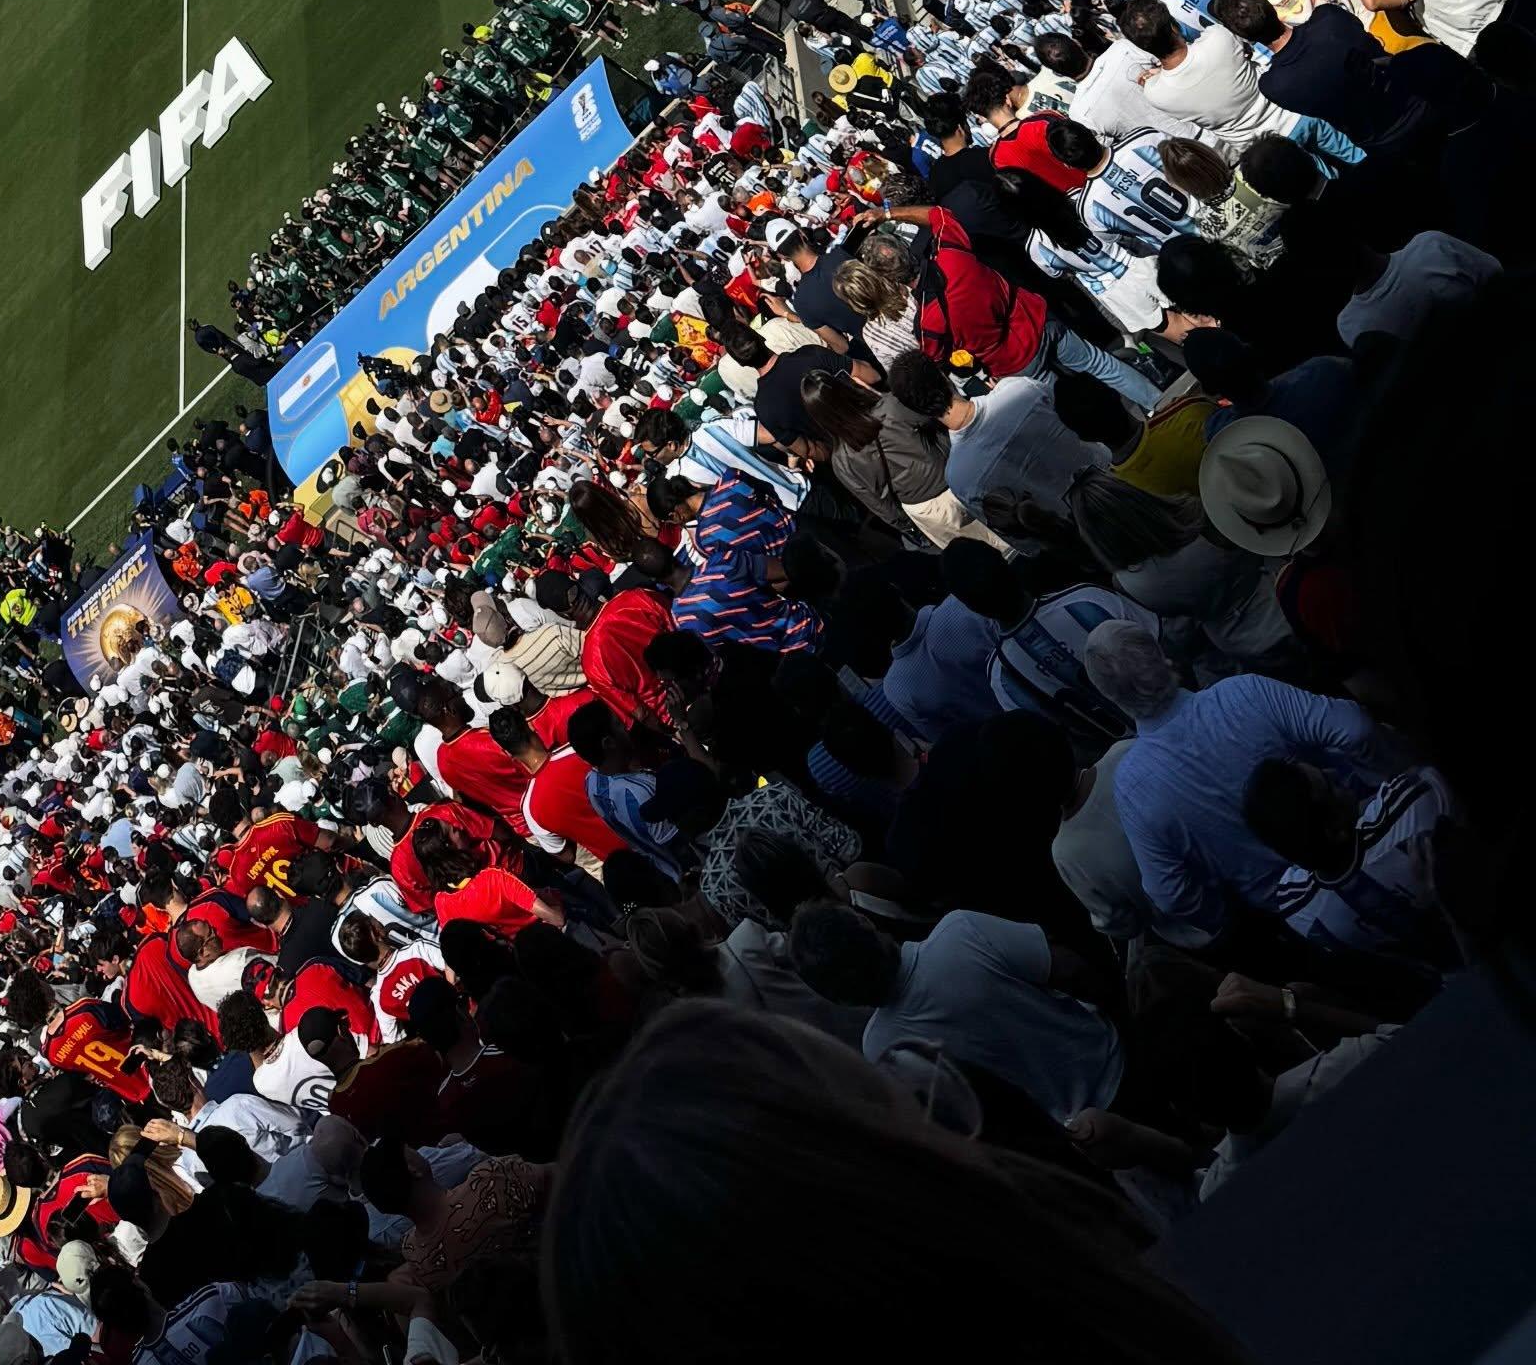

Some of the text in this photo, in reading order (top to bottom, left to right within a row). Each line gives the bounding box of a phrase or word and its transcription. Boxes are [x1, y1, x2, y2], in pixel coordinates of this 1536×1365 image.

[82, 34, 273, 272] FIFA
[1110, 168, 1141, 200] MESSI
[1122, 175, 1192, 237] 10
[376, 156, 536, 321] ARGENTINA
[511, 315, 528, 331] 15
[68, 555, 149, 639] THE FINAL
[391, 972, 420, 1001] SAKA
[53, 1020, 93, 1063] LAMINE YAMAL
[73, 1038, 127, 1080] 19
